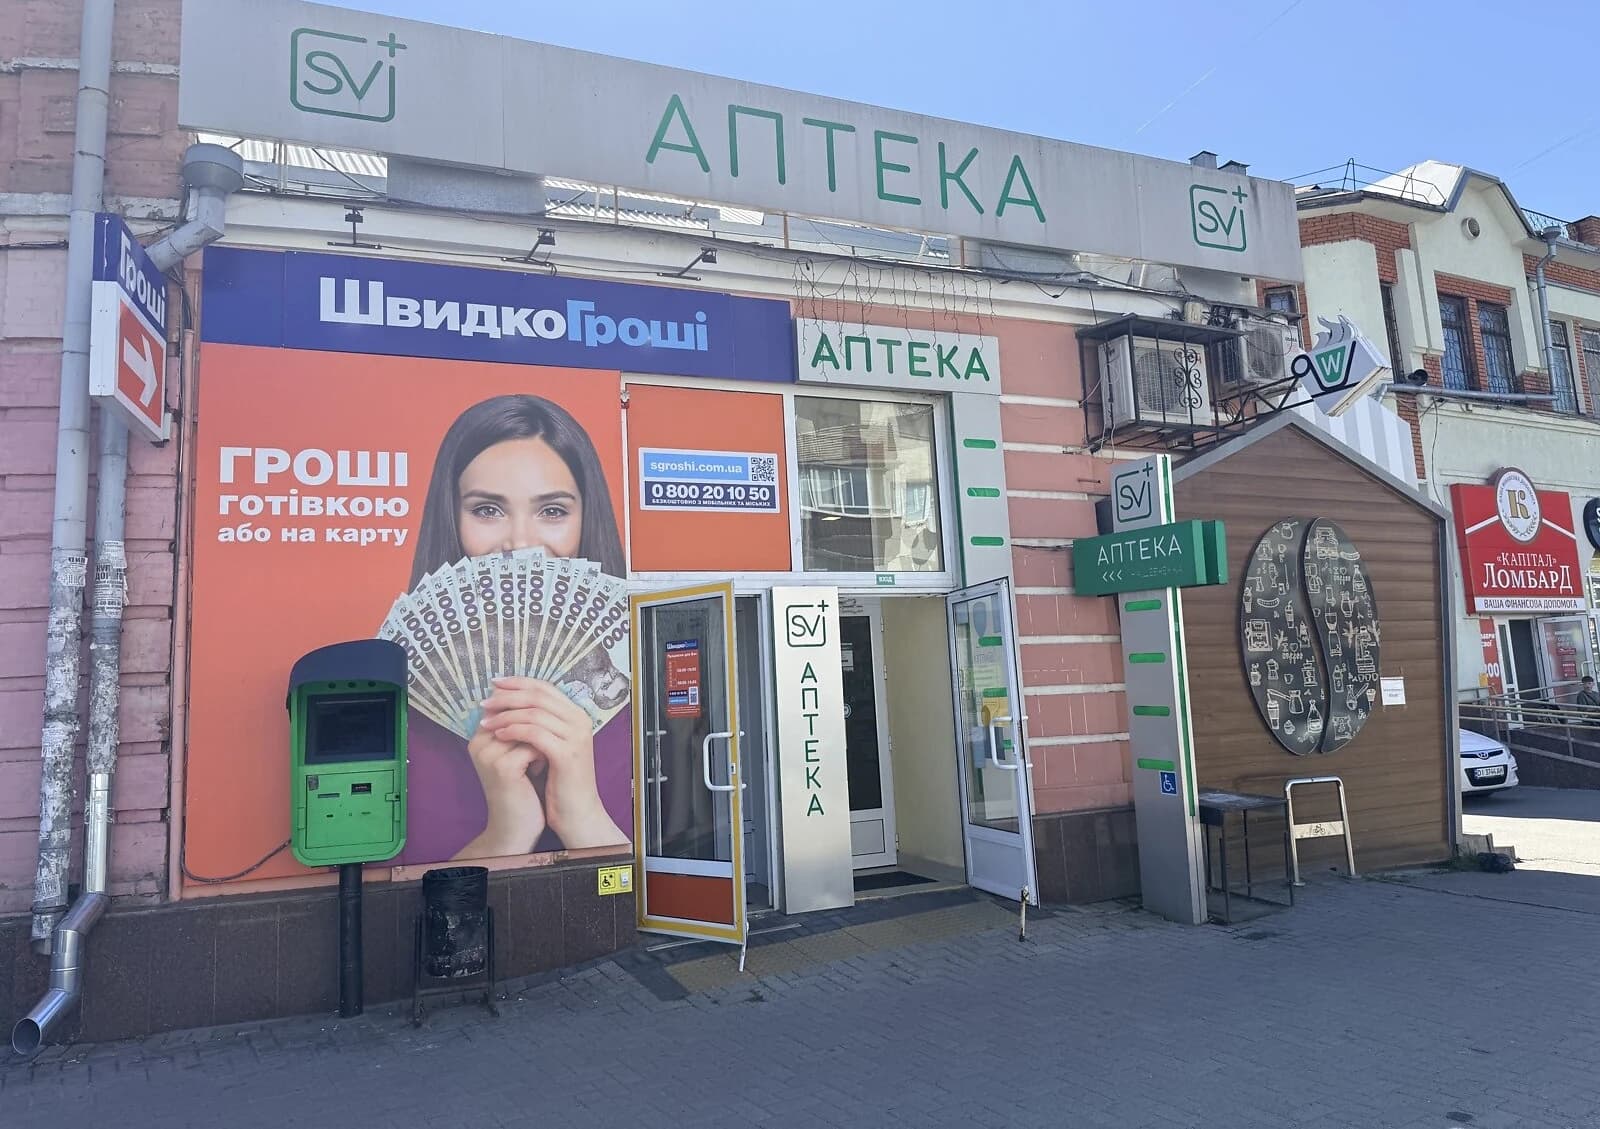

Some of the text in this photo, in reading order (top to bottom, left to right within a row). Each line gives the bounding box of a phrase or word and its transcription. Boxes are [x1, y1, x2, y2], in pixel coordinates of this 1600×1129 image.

[645, 94, 1046, 223] АПТЕКА
[120, 230, 166, 328] Гроші
[811, 333, 990, 382] АПТЕКА
[219, 446, 408, 487] ГРОШІ
[650, 461, 742, 473] sgroshi.com.ua
[219, 489, 409, 517] готівкою
[652, 483, 770, 501] 0 800 20 10 50
[218, 523, 408, 546] або на карту
[1097, 534, 1182, 566] АПТЕКА
[435, 588, 461, 634] 1000
[459, 583, 481, 630] 1000
[478, 568, 497, 614] 1000
[500, 572, 514, 618] 1000
[528, 569, 544, 614] 1000
[549, 575, 570, 619] 1000
[1484, 600, 1504, 608] ВАША
[1505, 599, 1542, 609] ФІНАНСОВА
[402, 610, 434, 652] 1000
[800, 662, 824, 816] АПТЕКА
